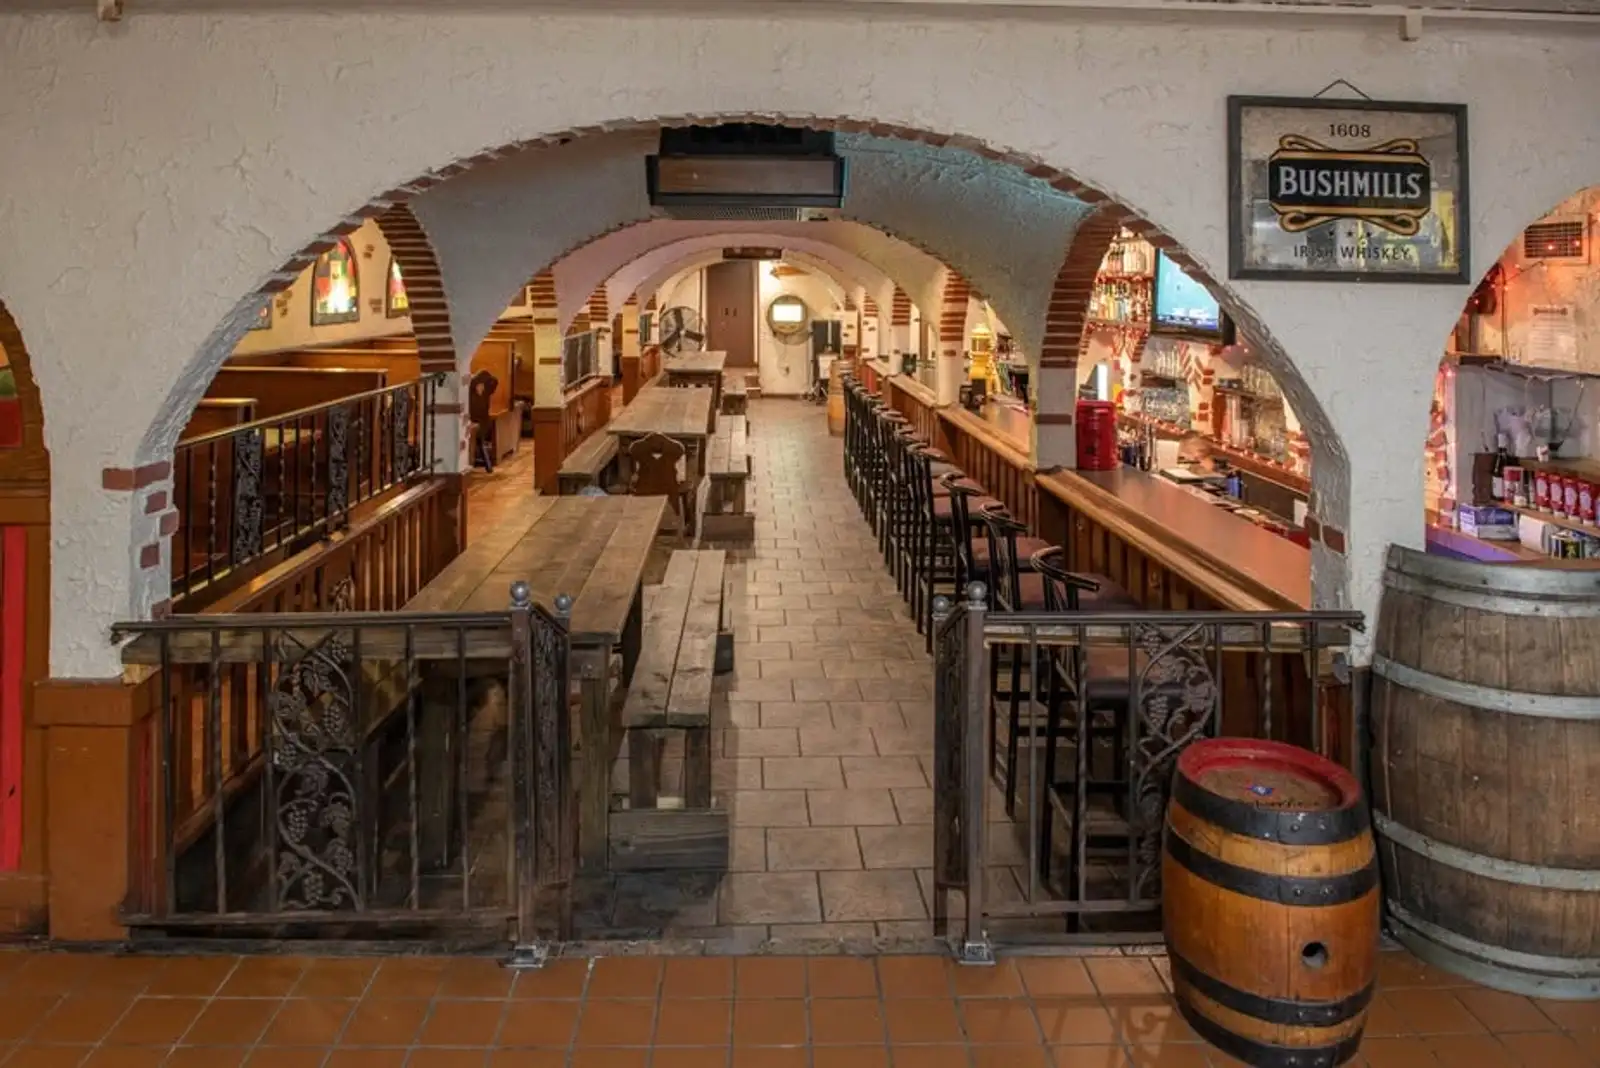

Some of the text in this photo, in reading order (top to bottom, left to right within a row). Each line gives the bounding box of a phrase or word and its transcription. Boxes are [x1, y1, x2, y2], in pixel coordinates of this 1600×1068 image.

[1329, 124, 1371, 138] 1608
[1278, 166, 1423, 199] BUSHMILLS
[1294, 244, 1410, 260] IRISH WHISKEY
